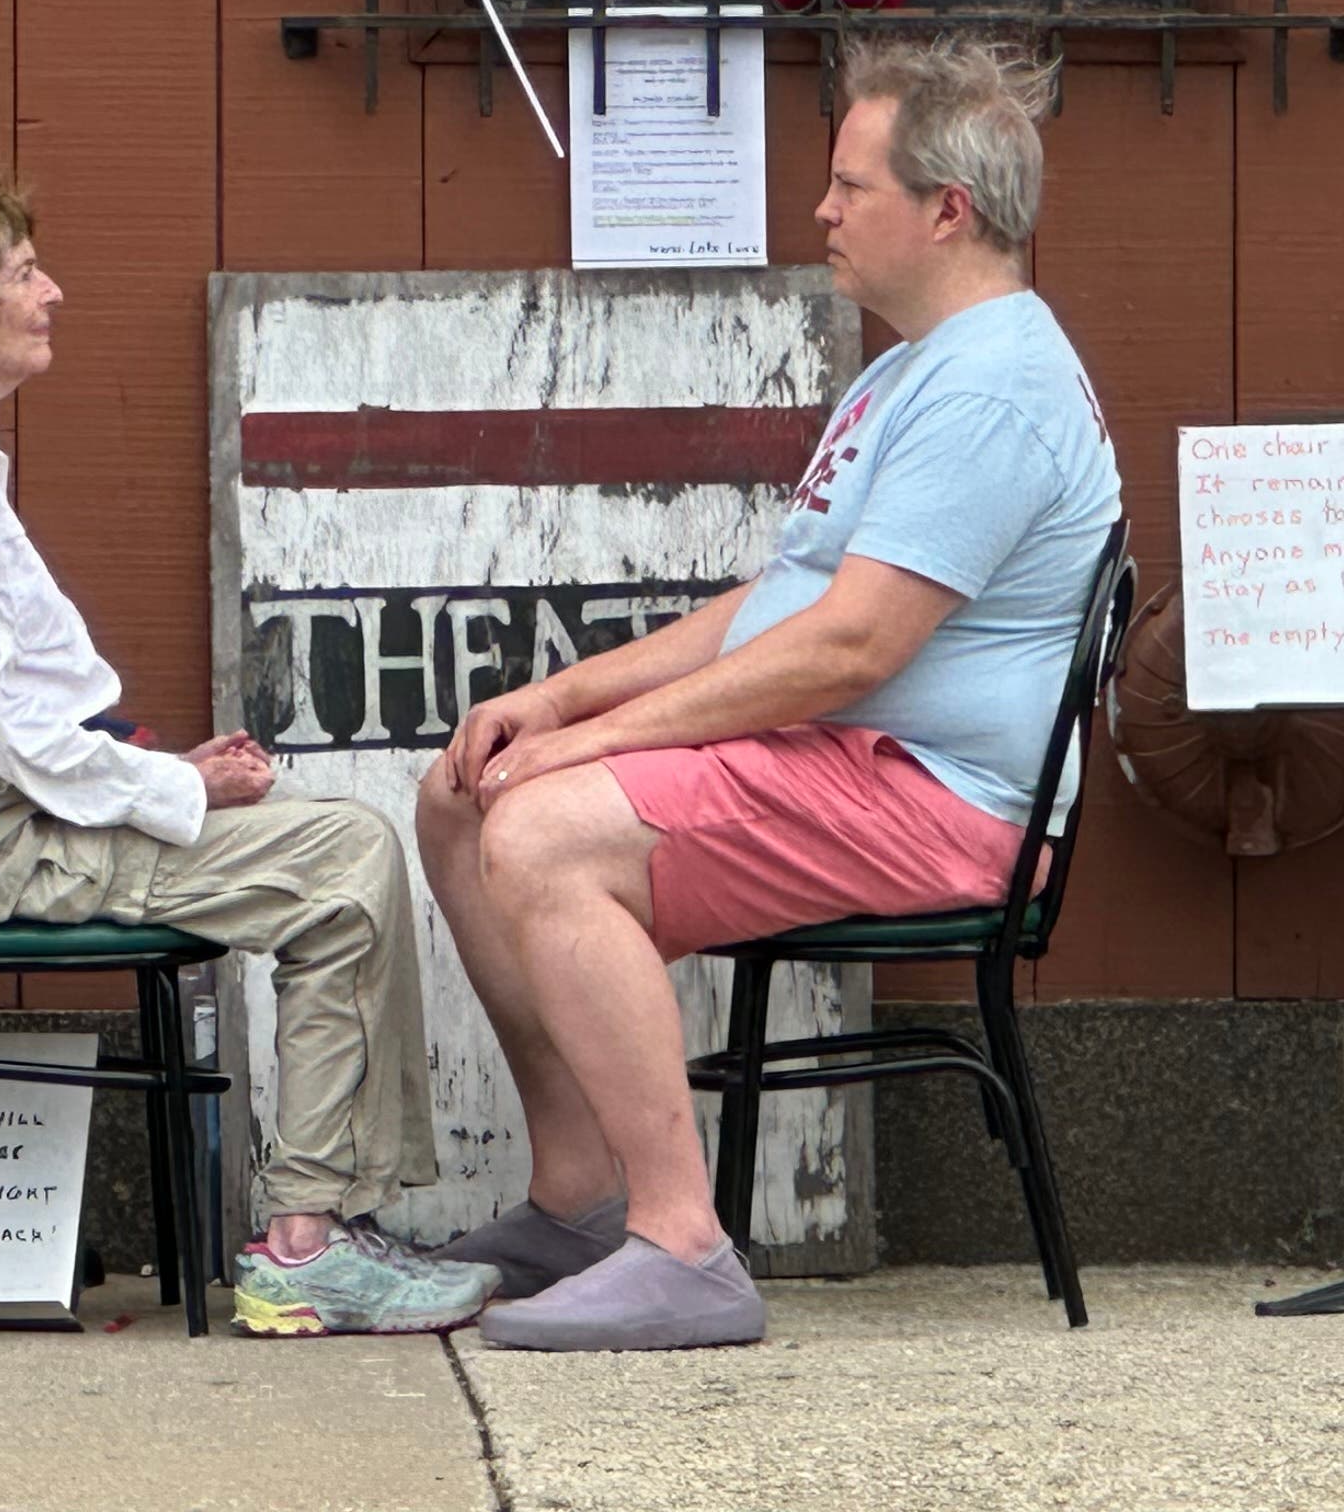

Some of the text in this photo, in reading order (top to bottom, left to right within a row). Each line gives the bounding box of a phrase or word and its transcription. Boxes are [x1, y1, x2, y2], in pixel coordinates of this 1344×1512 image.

[1192, 438, 1247, 460] One
[1263, 431, 1329, 457] chair
[1196, 474, 1225, 495] It
[1196, 506, 1303, 529] chooses
[1201, 543, 1304, 575] Anyone
[1202, 581, 1264, 608] Stay
[1286, 578, 1316, 593] as
[1204, 628, 1250, 646] The
